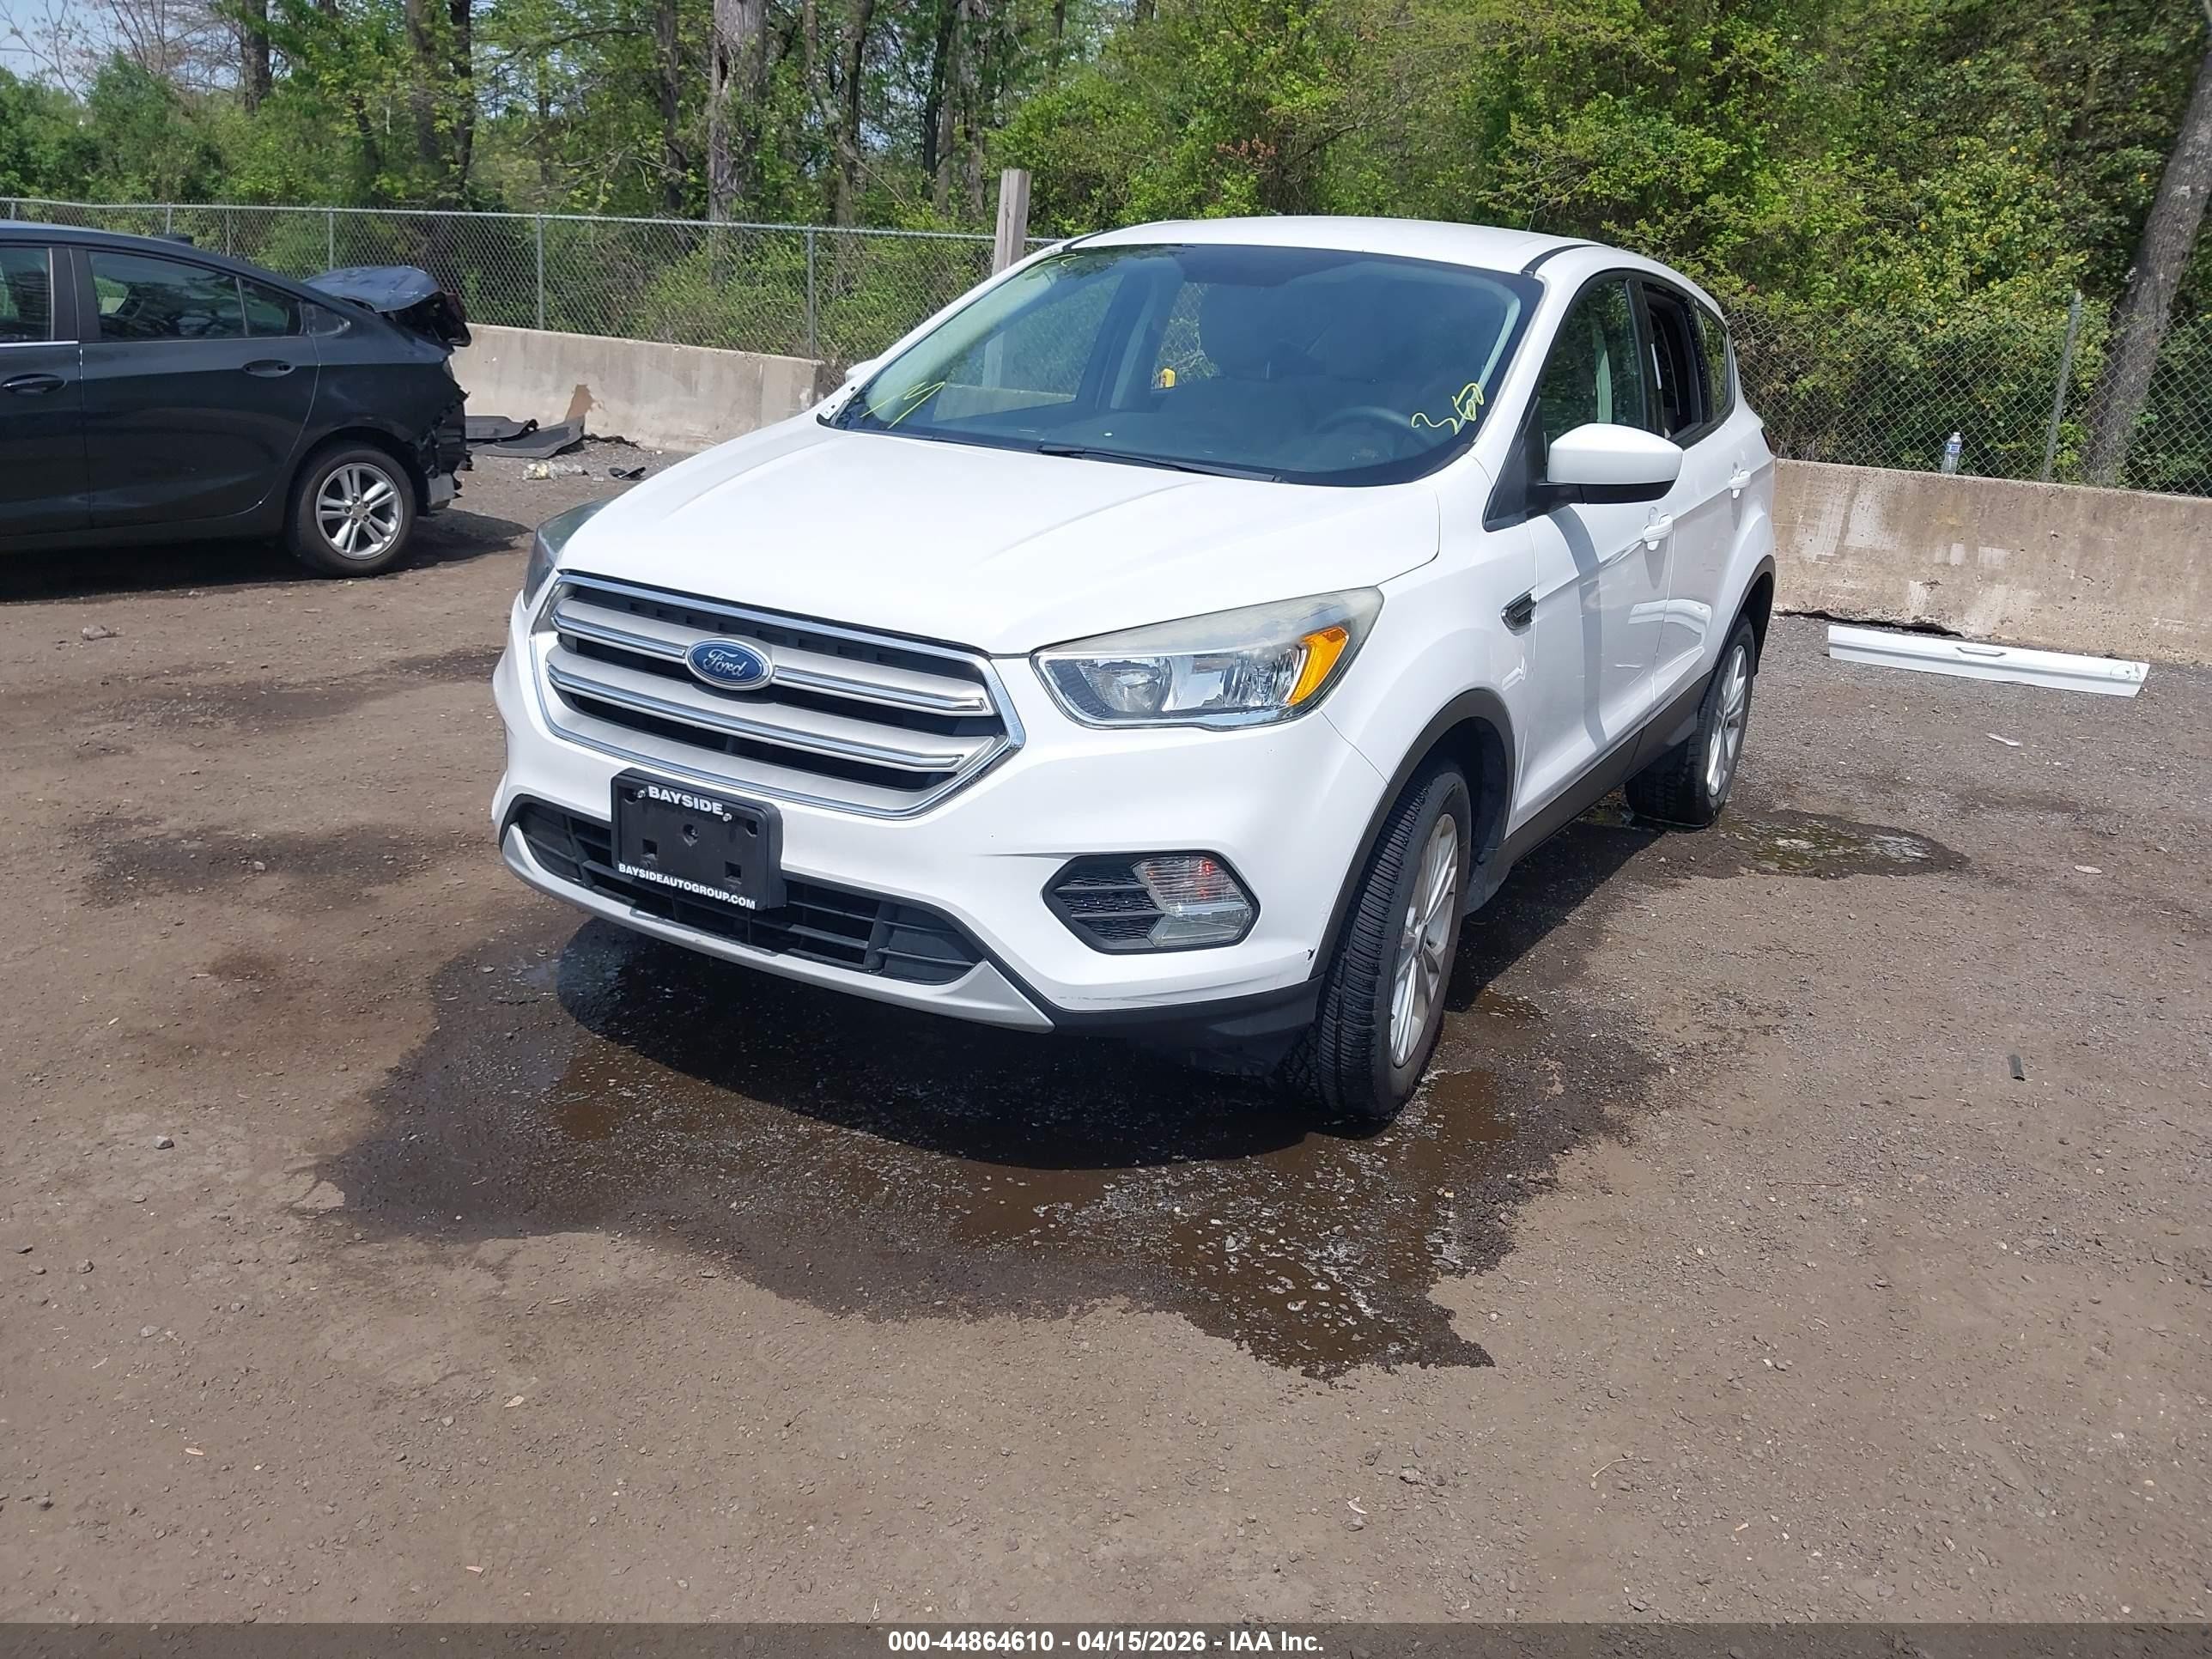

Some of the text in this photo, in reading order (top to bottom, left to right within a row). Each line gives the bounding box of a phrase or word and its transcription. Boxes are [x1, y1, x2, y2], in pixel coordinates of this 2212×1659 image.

[702, 648, 748, 677] Ford
[647, 785, 724, 816] BAYSIDE
[618, 862, 757, 910] BAYSIDEAUTOGROUP.COM
